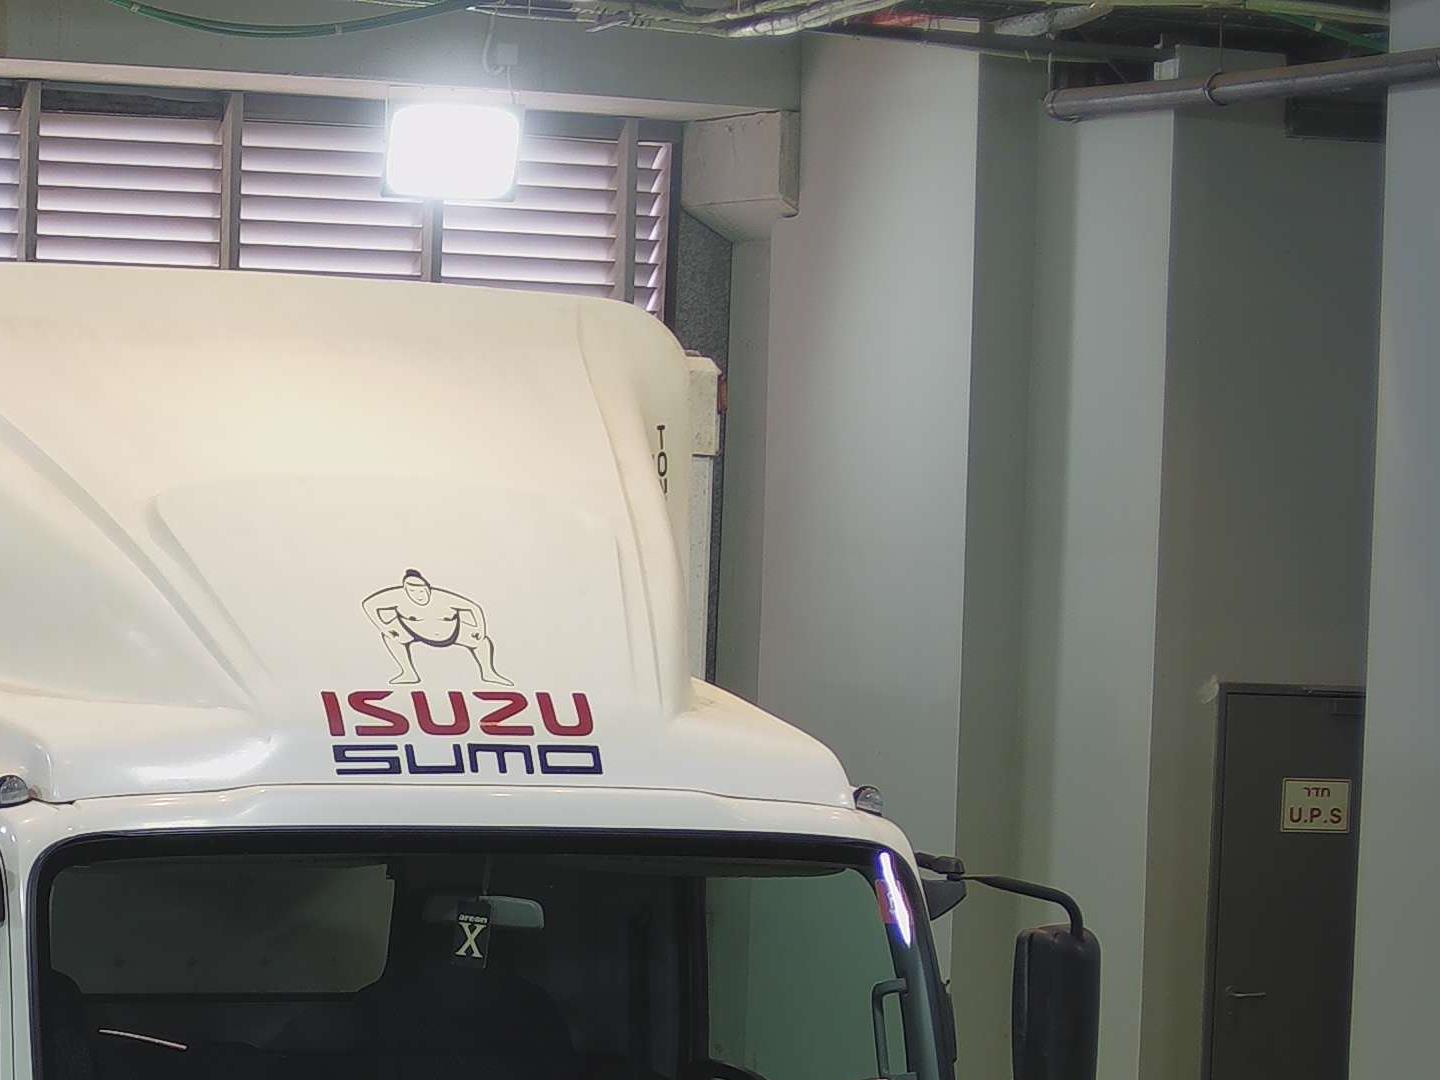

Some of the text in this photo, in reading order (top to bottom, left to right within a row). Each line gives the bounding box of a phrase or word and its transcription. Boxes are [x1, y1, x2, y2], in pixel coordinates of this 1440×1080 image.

[321, 690, 595, 738] ISUZU
[332, 742, 604, 776] SUMO
[1303, 786, 1331, 798] חדר
[1289, 806, 1343, 824] U.P.S
[455, 921, 487, 959] X
